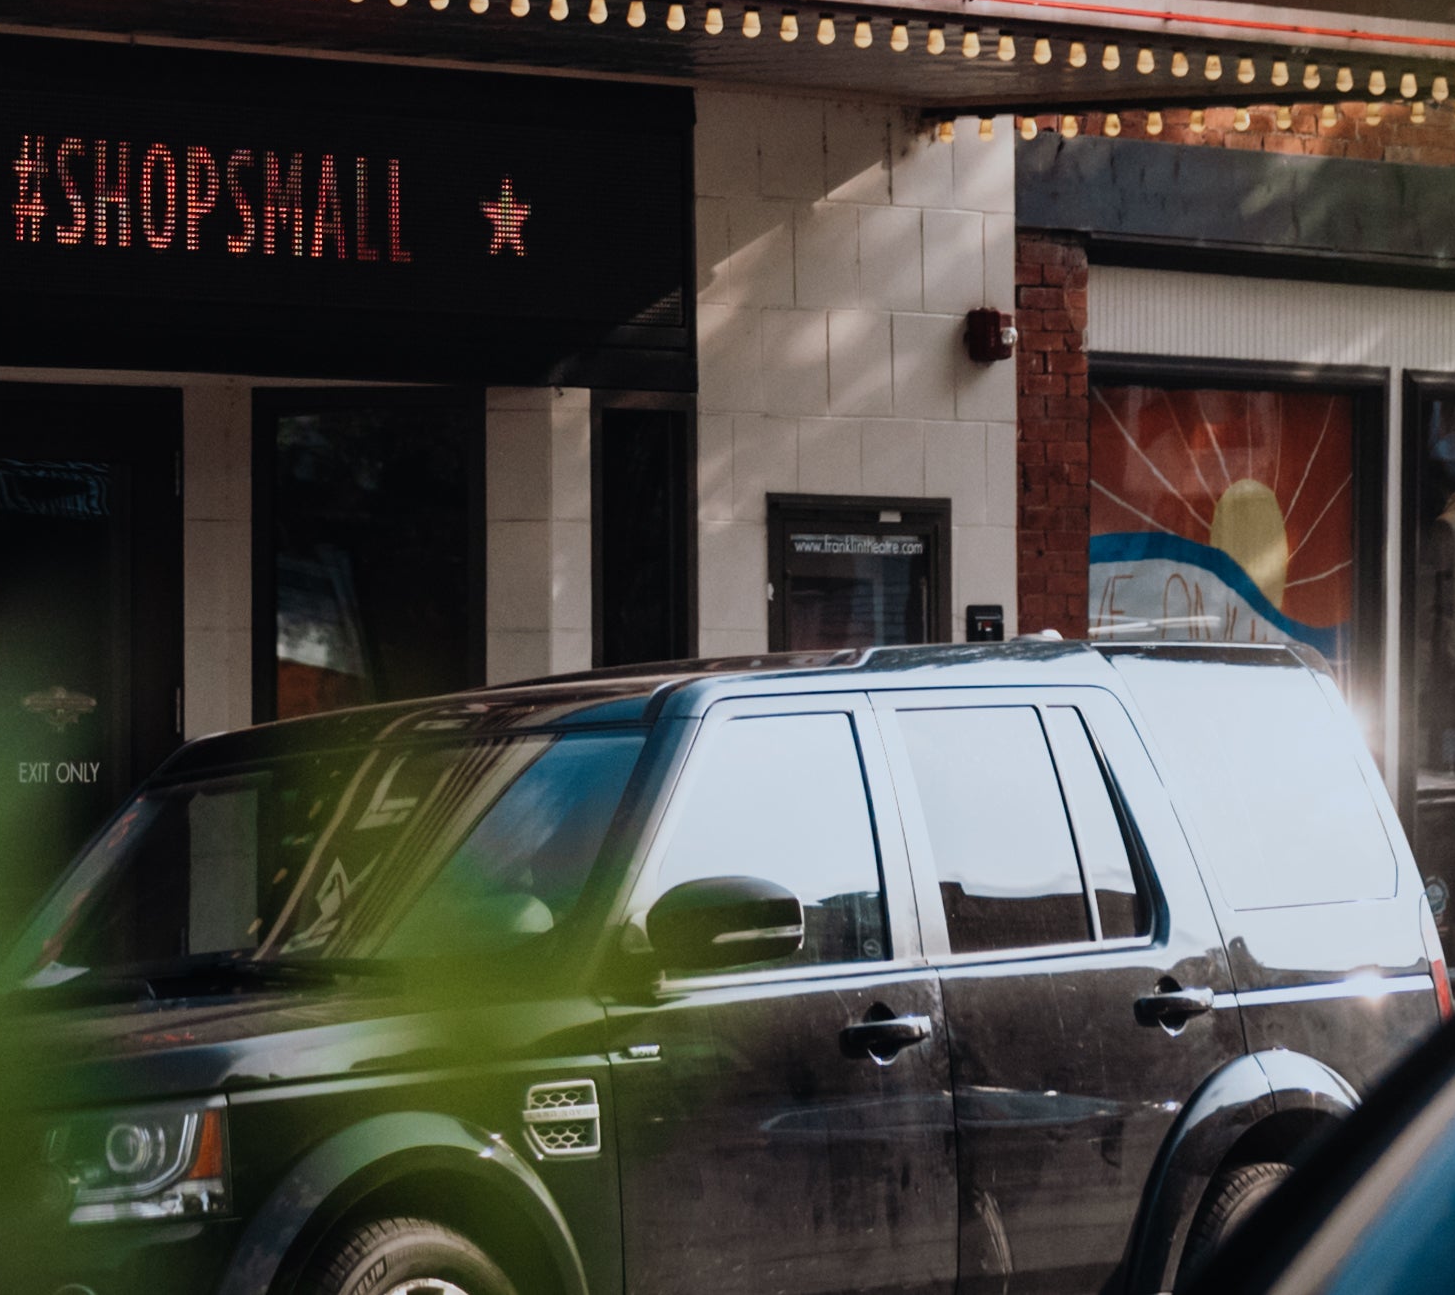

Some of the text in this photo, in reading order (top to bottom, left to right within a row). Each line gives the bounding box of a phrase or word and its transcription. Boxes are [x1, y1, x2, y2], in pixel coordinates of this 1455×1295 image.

[12, 133, 413, 264] #SHOPSMALL
[793, 534, 924, 555] www.franklintheatre.com
[18, 761, 100, 784] EXIT ONLY
